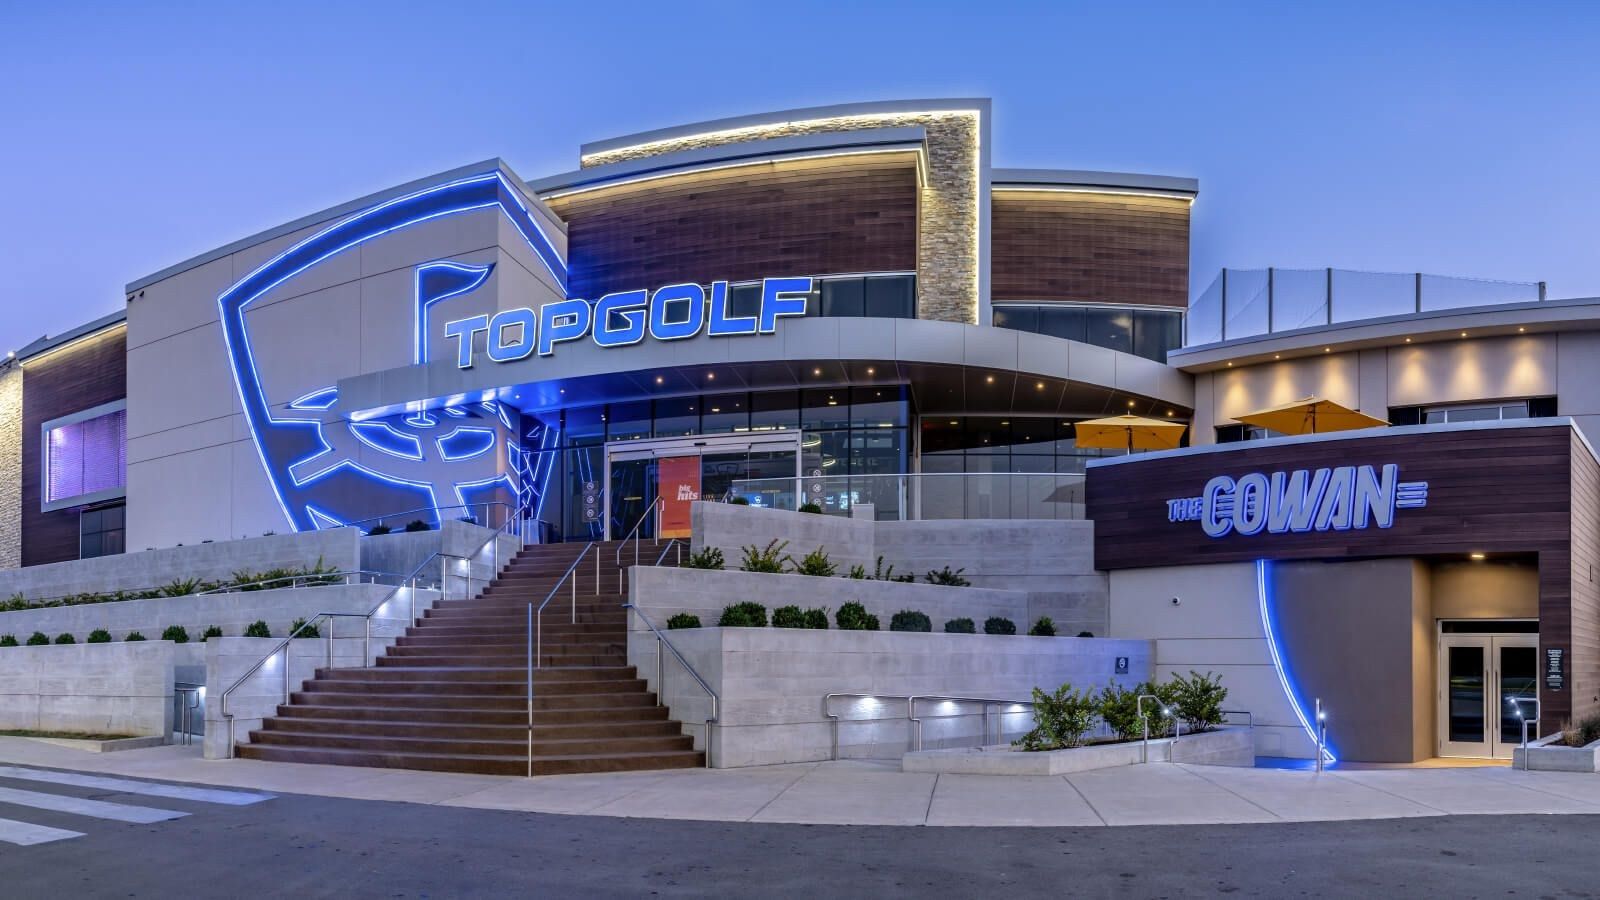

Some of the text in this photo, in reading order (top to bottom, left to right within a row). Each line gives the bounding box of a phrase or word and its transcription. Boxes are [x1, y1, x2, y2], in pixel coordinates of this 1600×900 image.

[444, 276, 813, 369] TOPGOLF
[676, 490, 699, 501] hits
[678, 484, 692, 494] big
[1166, 463, 1399, 538] THE COWAN
